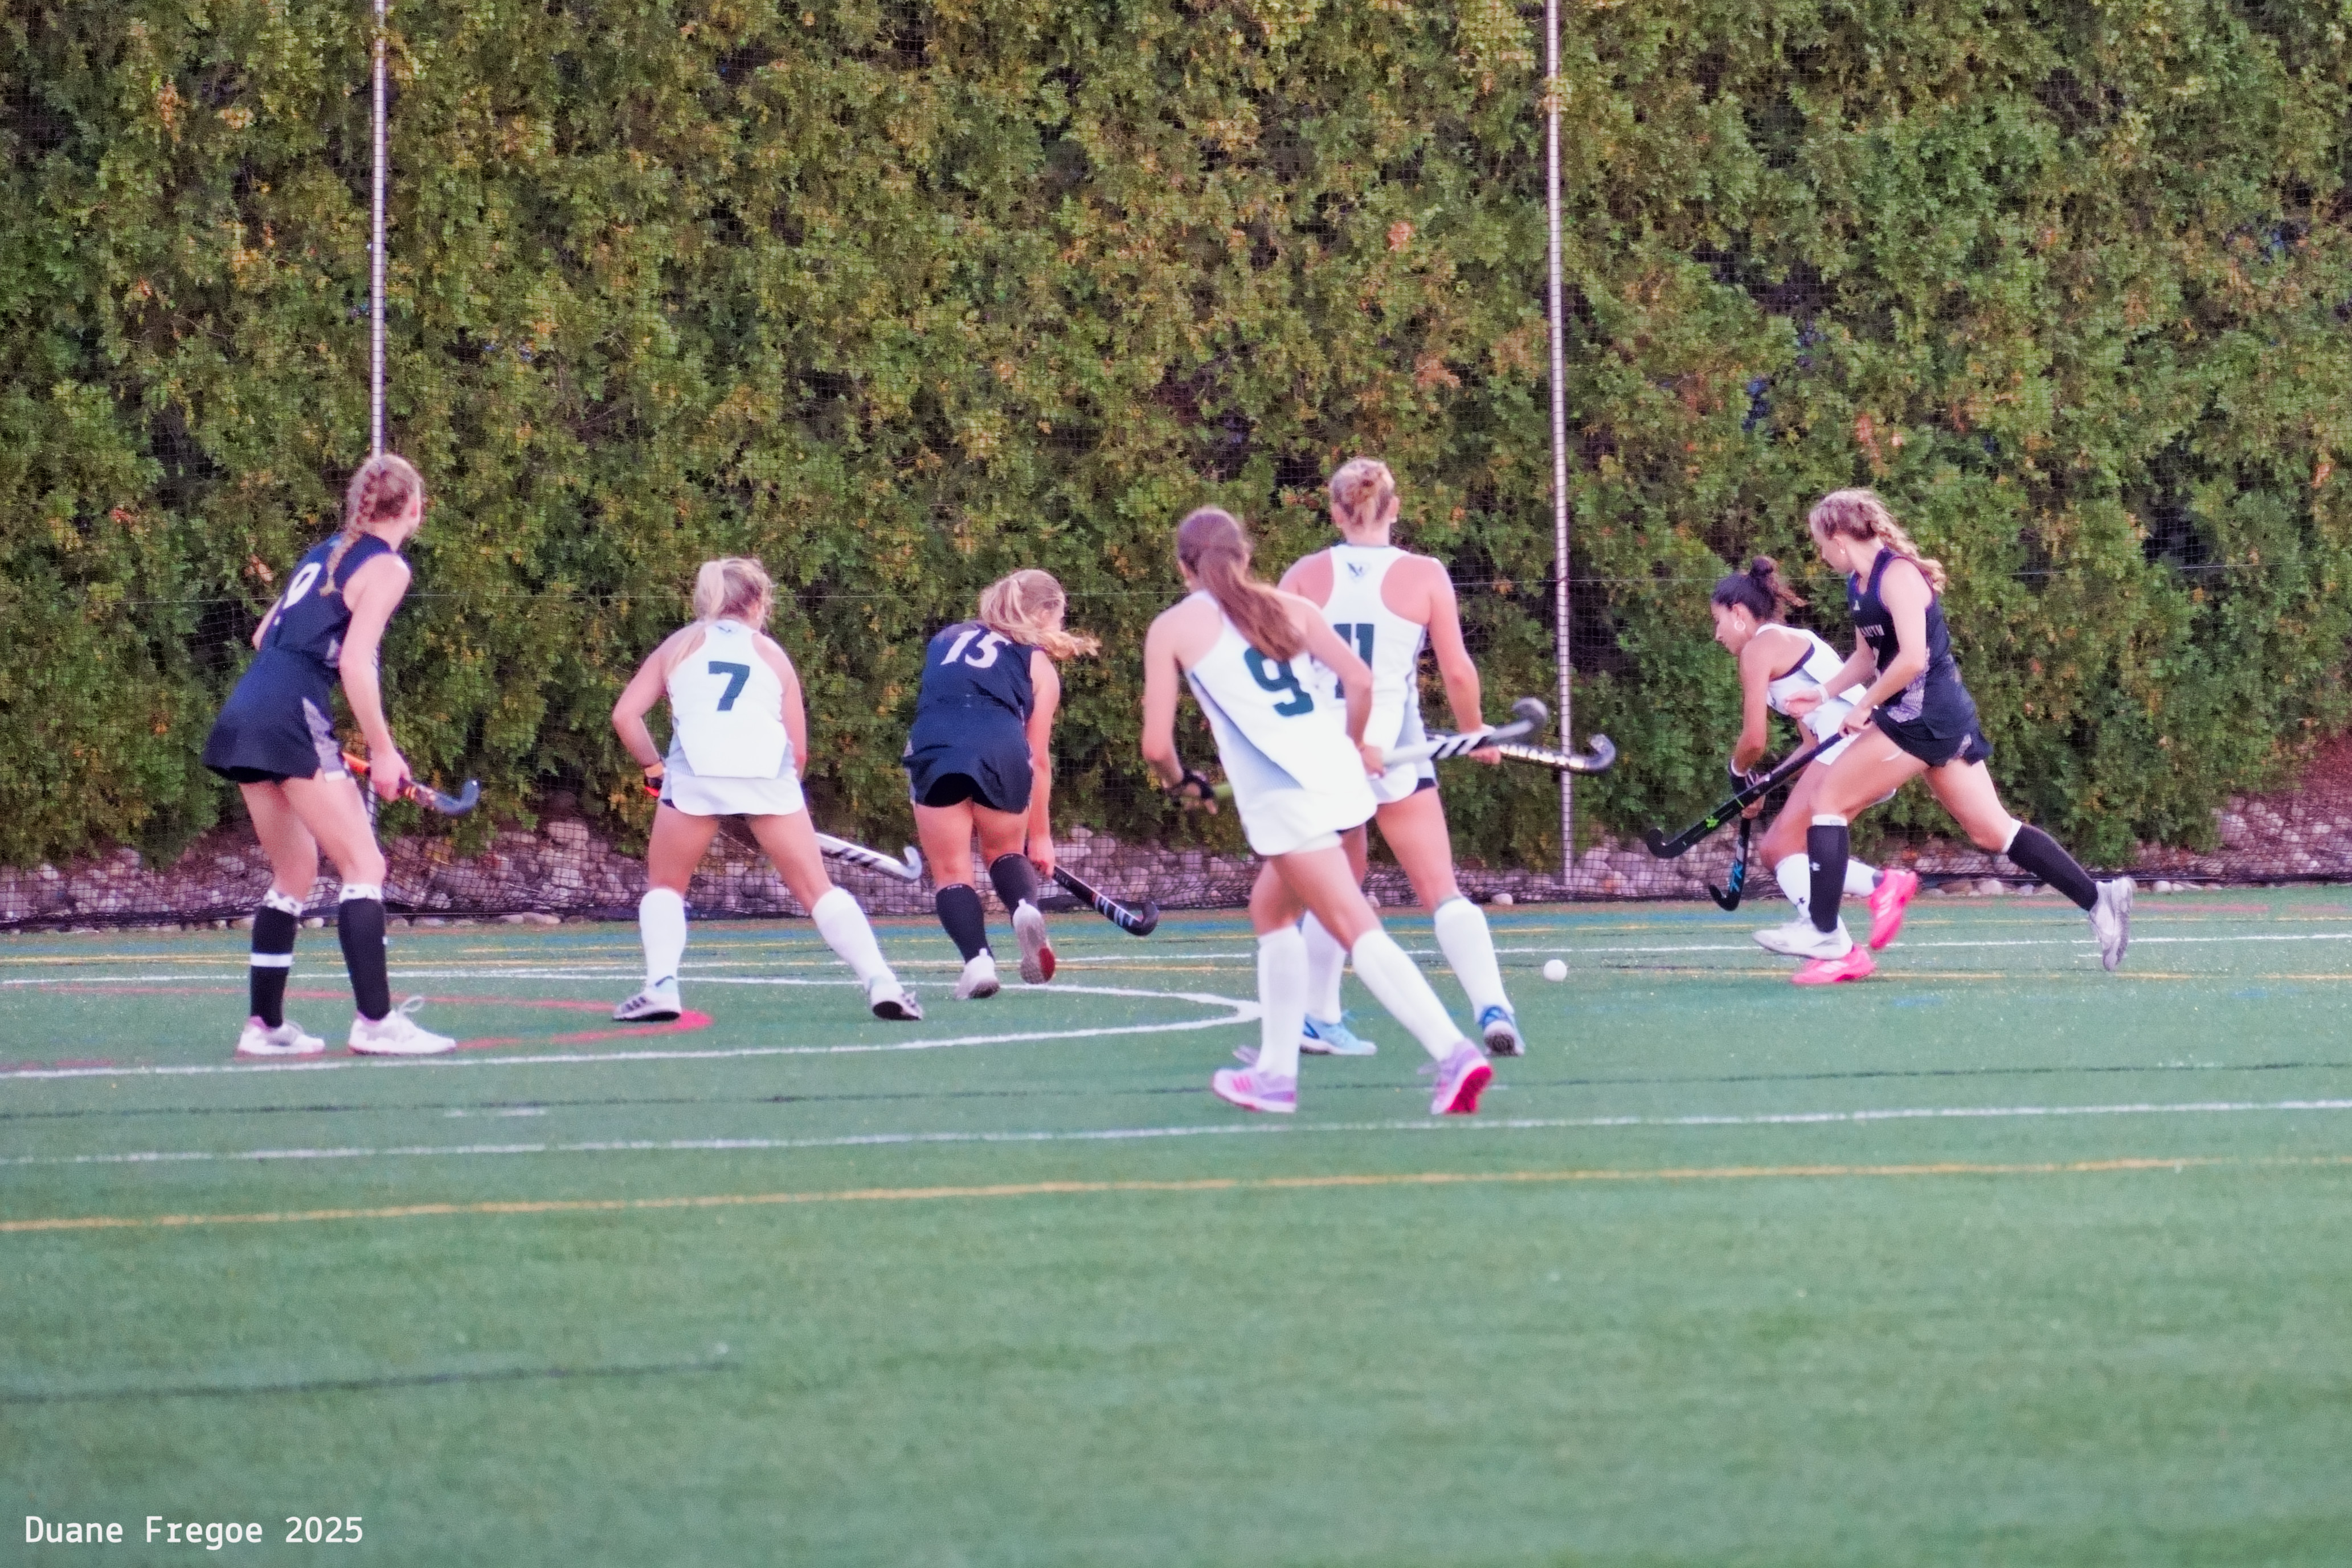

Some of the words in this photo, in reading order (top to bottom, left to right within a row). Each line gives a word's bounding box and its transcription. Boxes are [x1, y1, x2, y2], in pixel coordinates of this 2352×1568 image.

[940, 629, 1012, 669] 15
[708, 661, 750, 711] 7
[1244, 646, 1314, 717] 9
